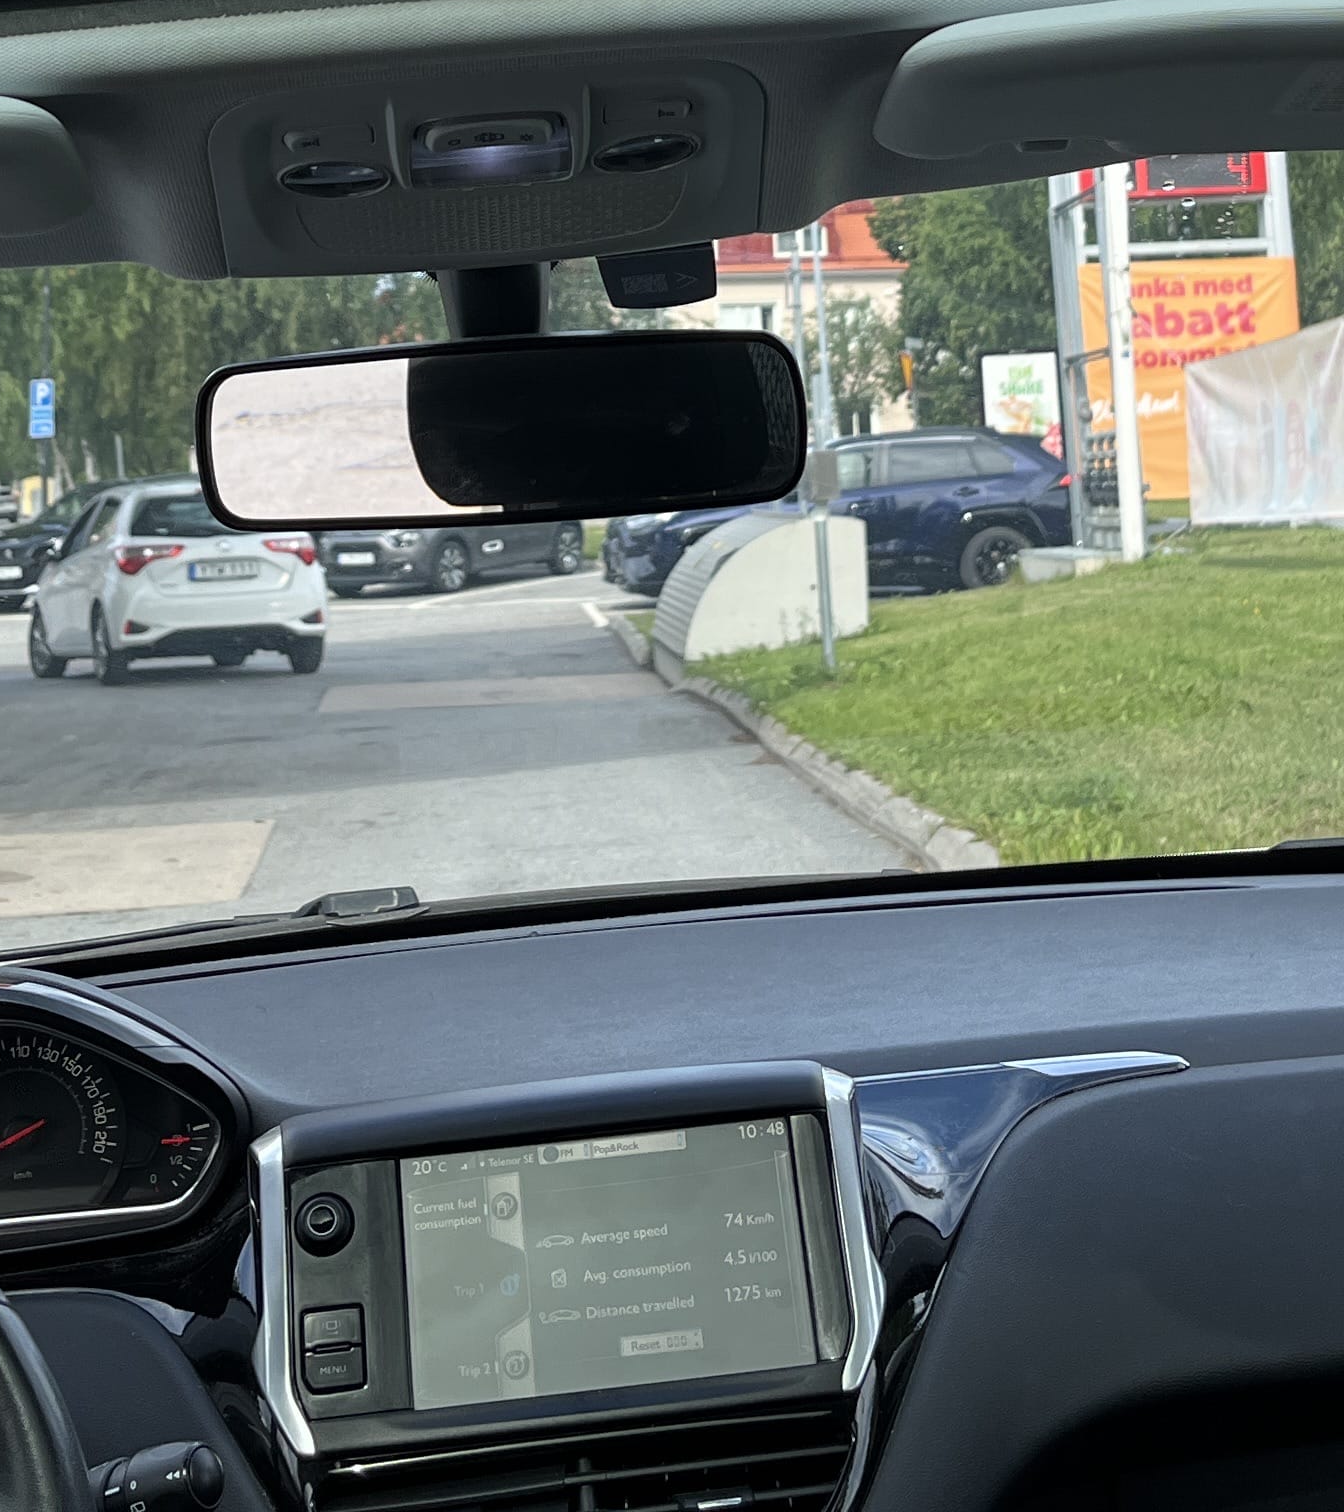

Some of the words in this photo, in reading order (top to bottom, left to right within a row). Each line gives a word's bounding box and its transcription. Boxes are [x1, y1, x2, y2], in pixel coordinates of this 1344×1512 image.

[1193, 273, 1254, 297] med
[1132, 301, 1256, 338] abatt
[10, 1045, 30, 1059] 110
[37, 1045, 59, 1064] 130
[61, 1055, 84, 1078] 150
[81, 1074, 100, 1100] 170
[91, 1099, 107, 1126] 190
[737, 1121, 786, 1141] 10:48
[92, 1130, 107, 1154] 210
[593, 1141, 640, 1156] Pop&Rock
[488, 1156, 522, 1168] Telenor
[522, 1153, 534, 1164] SE
[559, 1148, 574, 1158] FM
[413, 1202, 455, 1215] Current
[457, 1198, 477, 1210] fuel
[414, 1215, 482, 1231] consumption
[723, 1212, 744, 1228] 74
[746, 1212, 775, 1226] Km/h
[580, 1229, 631, 1246] Average
[633, 1224, 669, 1240] speed
[612, 1261, 692, 1280] consumption
[454, 1284, 476, 1297] Trip
[723, 1284, 761, 1303] 1275
[764, 1287, 782, 1298] km
[585, 1303, 640, 1320] Distance
[642, 1294, 695, 1313] travelled
[630, 1339, 661, 1353] Reset
[319, 1364, 347, 1376] MENU
[459, 1364, 481, 1379] Trip
[482, 1362, 492, 1375] 2
